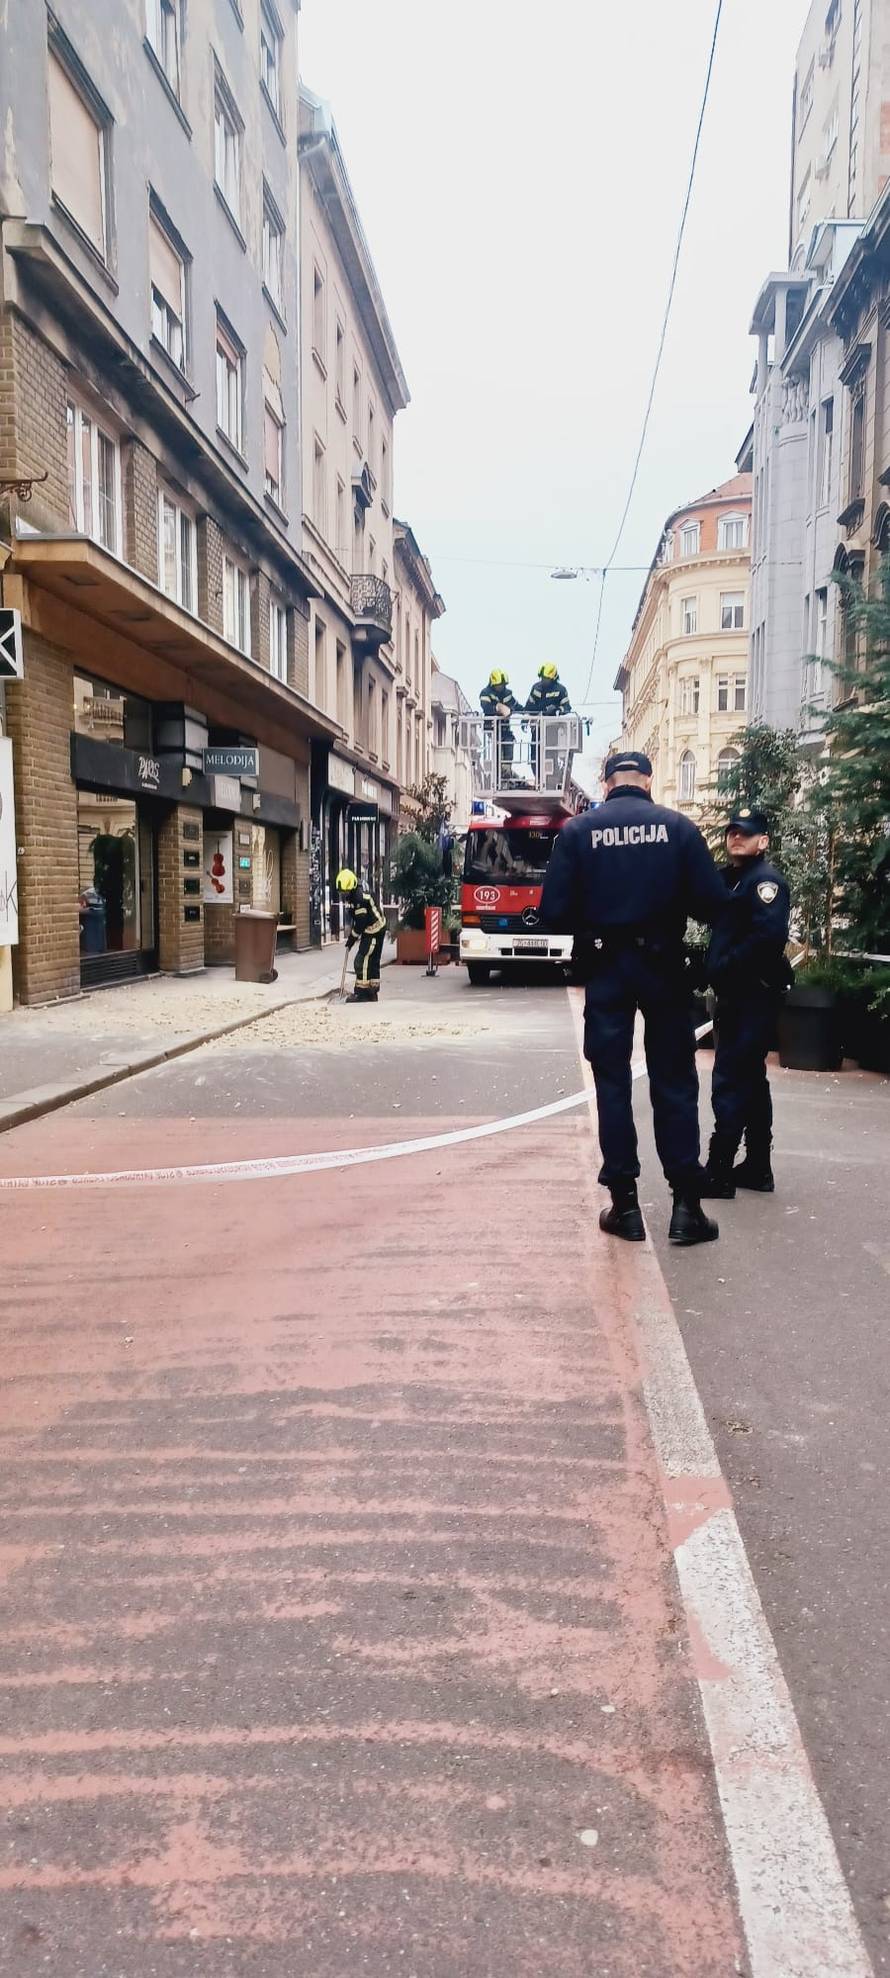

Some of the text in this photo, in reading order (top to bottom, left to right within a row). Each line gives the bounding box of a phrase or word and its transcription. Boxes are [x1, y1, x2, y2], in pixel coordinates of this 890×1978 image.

[206, 755, 254, 769] MELODIJA
[591, 824, 669, 849] POLICIJA
[480, 890, 496, 901] 193
